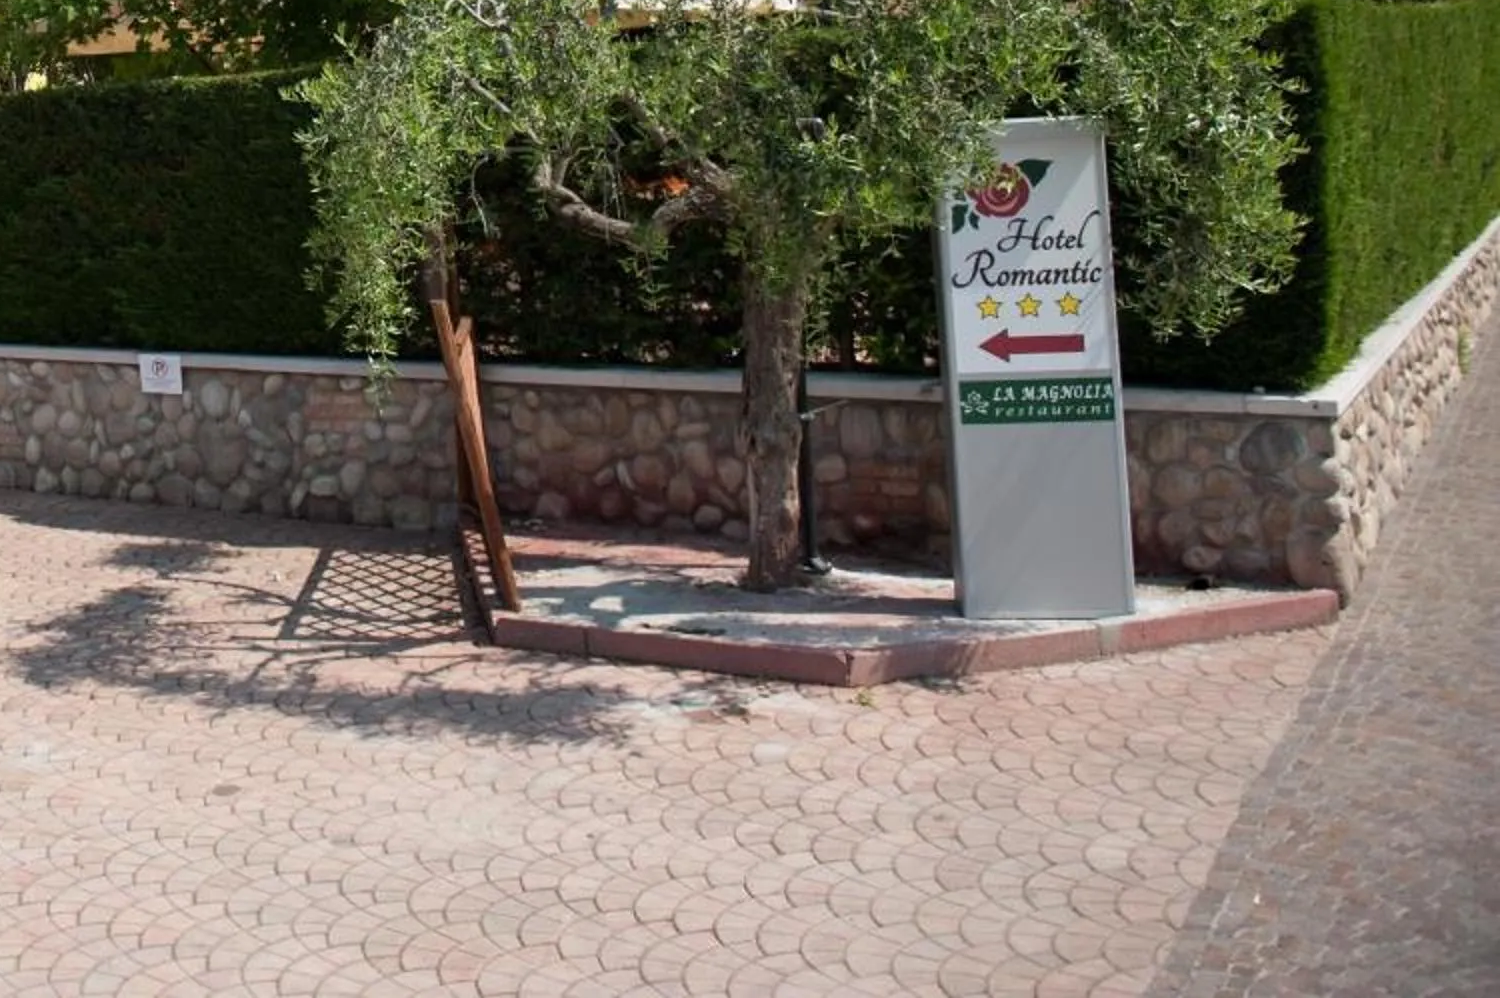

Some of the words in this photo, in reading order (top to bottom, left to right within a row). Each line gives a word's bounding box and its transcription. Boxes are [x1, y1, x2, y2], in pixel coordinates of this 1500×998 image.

[998, 210, 1100, 252] Hotel
[952, 250, 1103, 289] Romantic
[993, 386, 1016, 402] LA
[1021, 384, 1114, 403] MAGNOLIA
[995, 403, 1110, 417] restaurant
